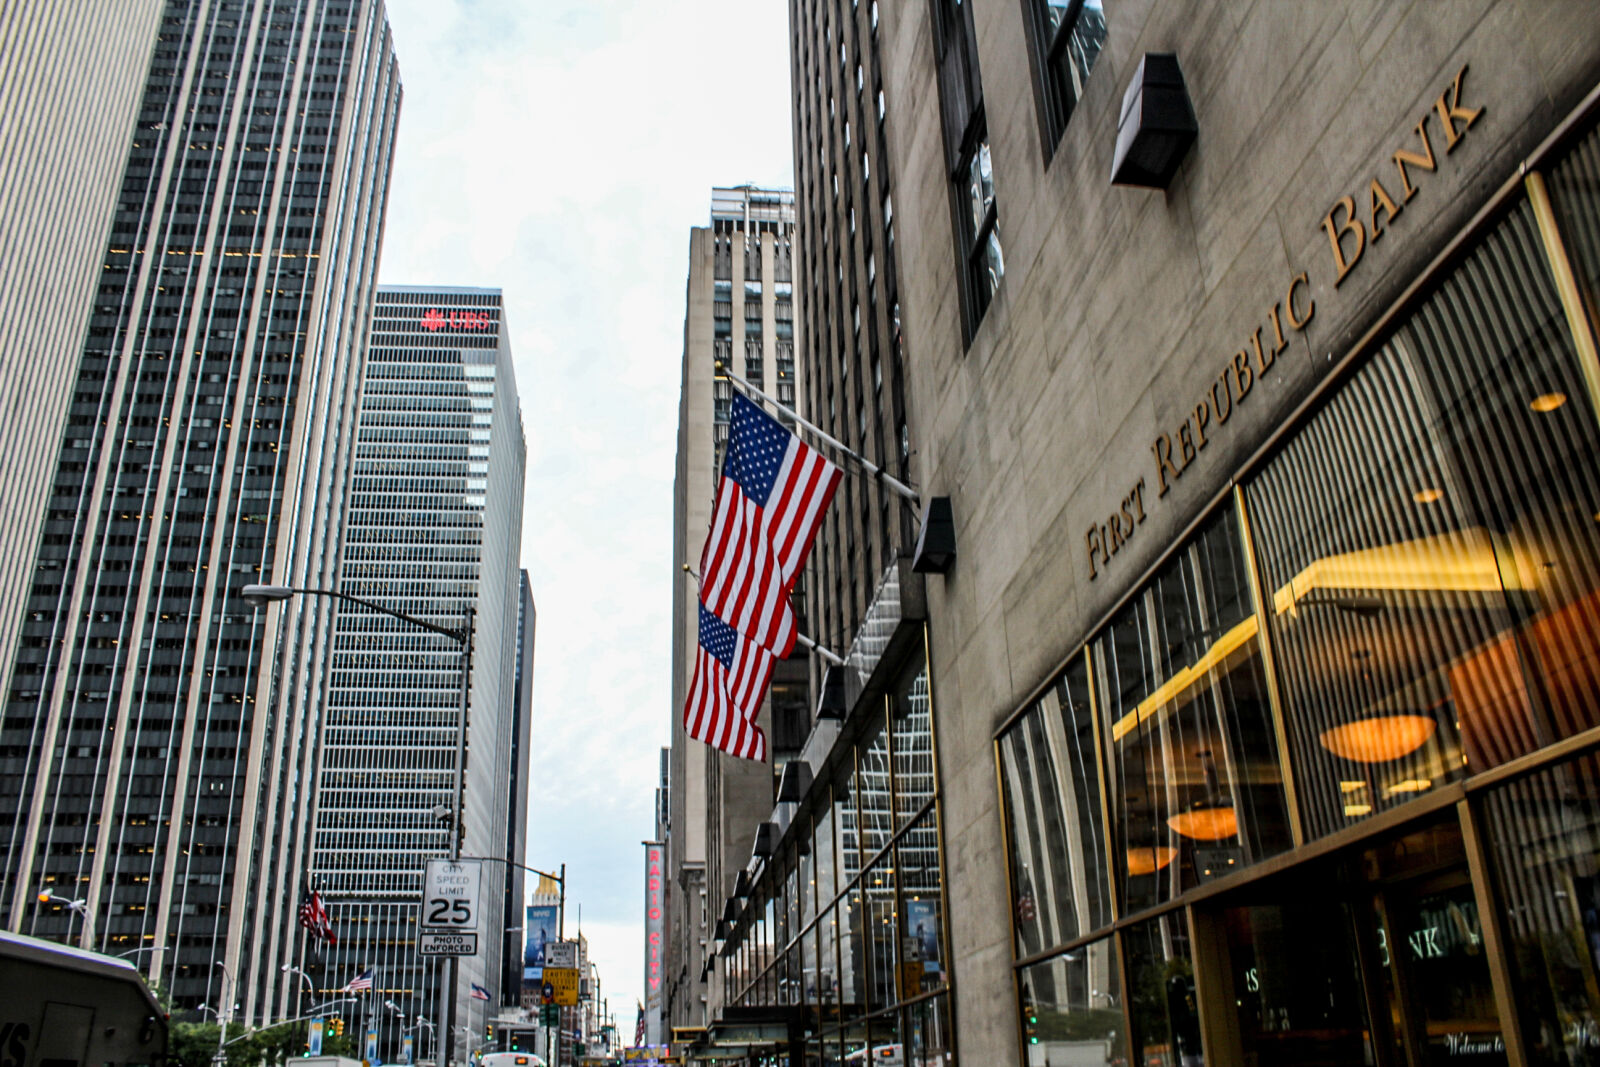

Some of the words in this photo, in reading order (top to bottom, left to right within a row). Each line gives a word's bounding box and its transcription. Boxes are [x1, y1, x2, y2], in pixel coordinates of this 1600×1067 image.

[448, 311, 489, 329] UBS
[1083, 478, 1147, 581] FIRST
[1151, 271, 1316, 499] REPUBLIC
[1320, 63, 1486, 288] BANK
[442, 865, 465, 873] CITY
[436, 876, 470, 884] SPEED
[648, 850, 661, 920] RADIO
[439, 887, 465, 895] LIMIT
[428, 899, 471, 924] 25
[424, 944, 472, 952] ENFORCED
[433, 936, 464, 944] PHOTO
[648, 933, 661, 990] CITY
[1444, 1032, 1492, 1056] Welcome
